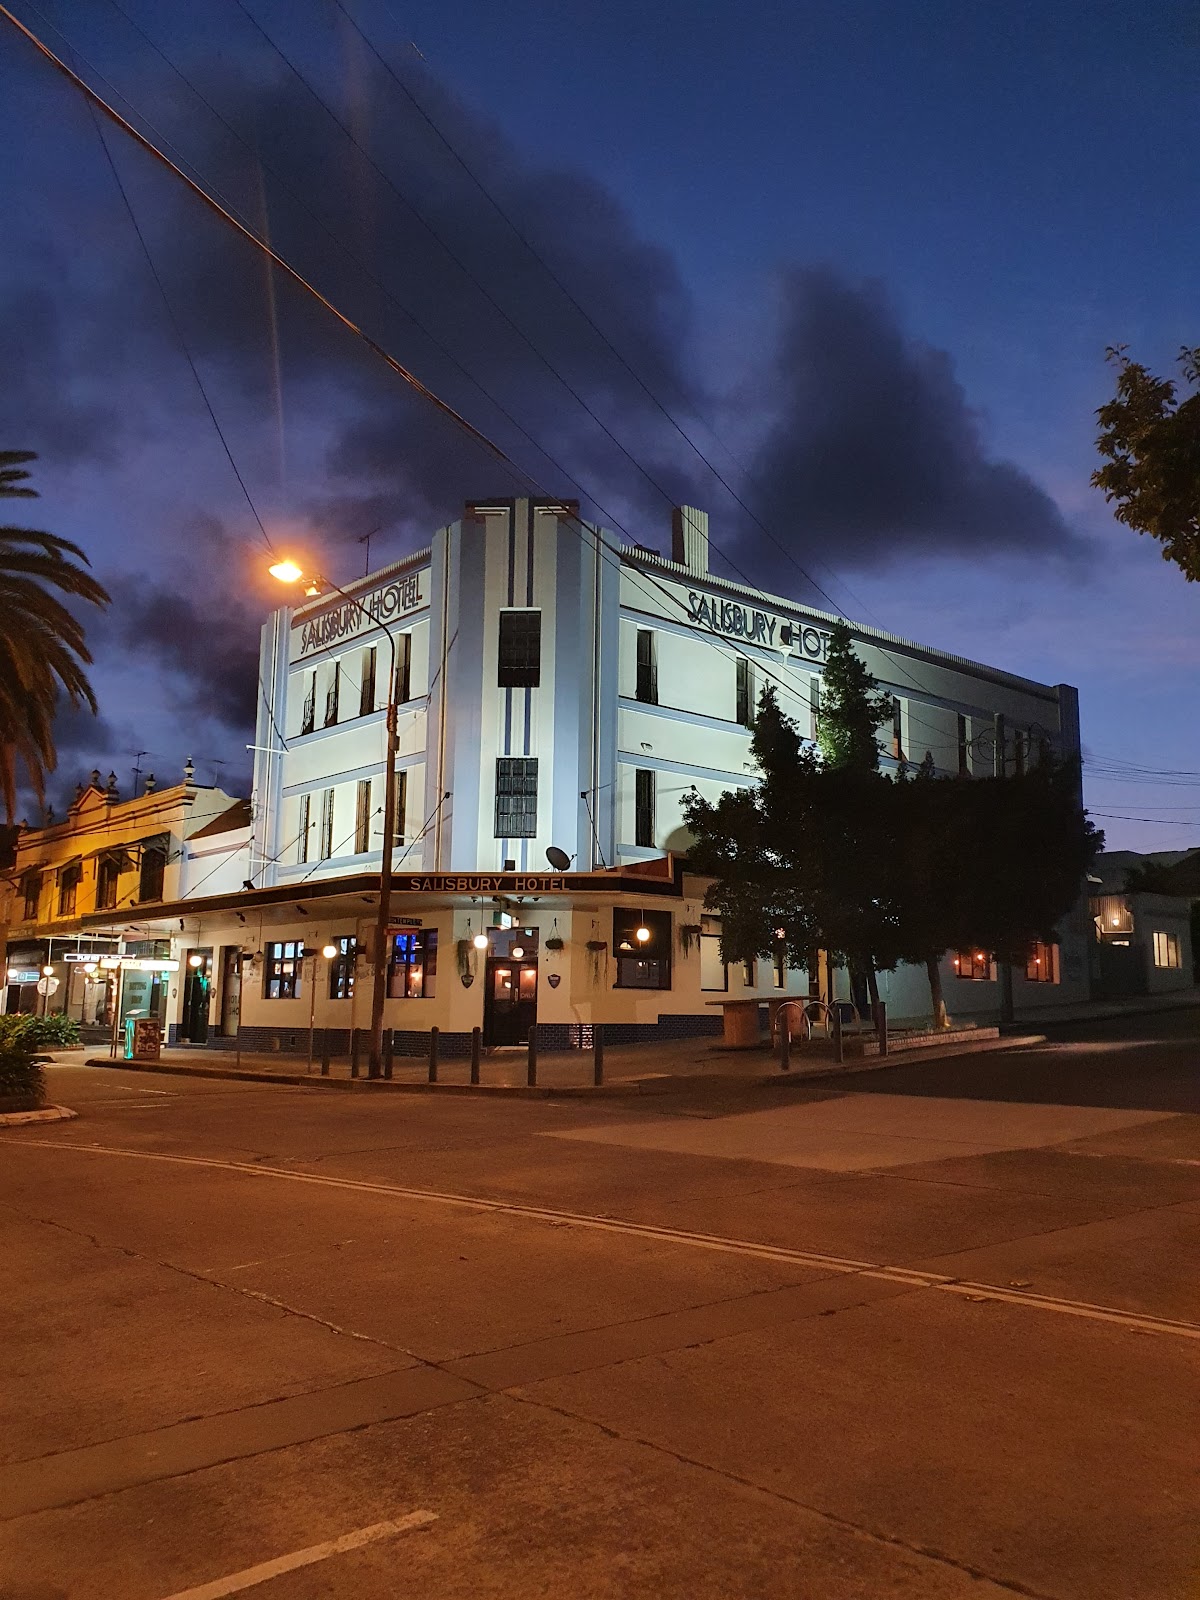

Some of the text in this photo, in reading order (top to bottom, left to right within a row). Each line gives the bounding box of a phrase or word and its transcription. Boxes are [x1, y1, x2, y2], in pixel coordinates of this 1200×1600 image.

[300, 573, 423, 655] SALISBURY HOTEL
[687, 591, 830, 662] SALISBURY HOT
[410, 877, 571, 891] SALISBURY HOTEL
